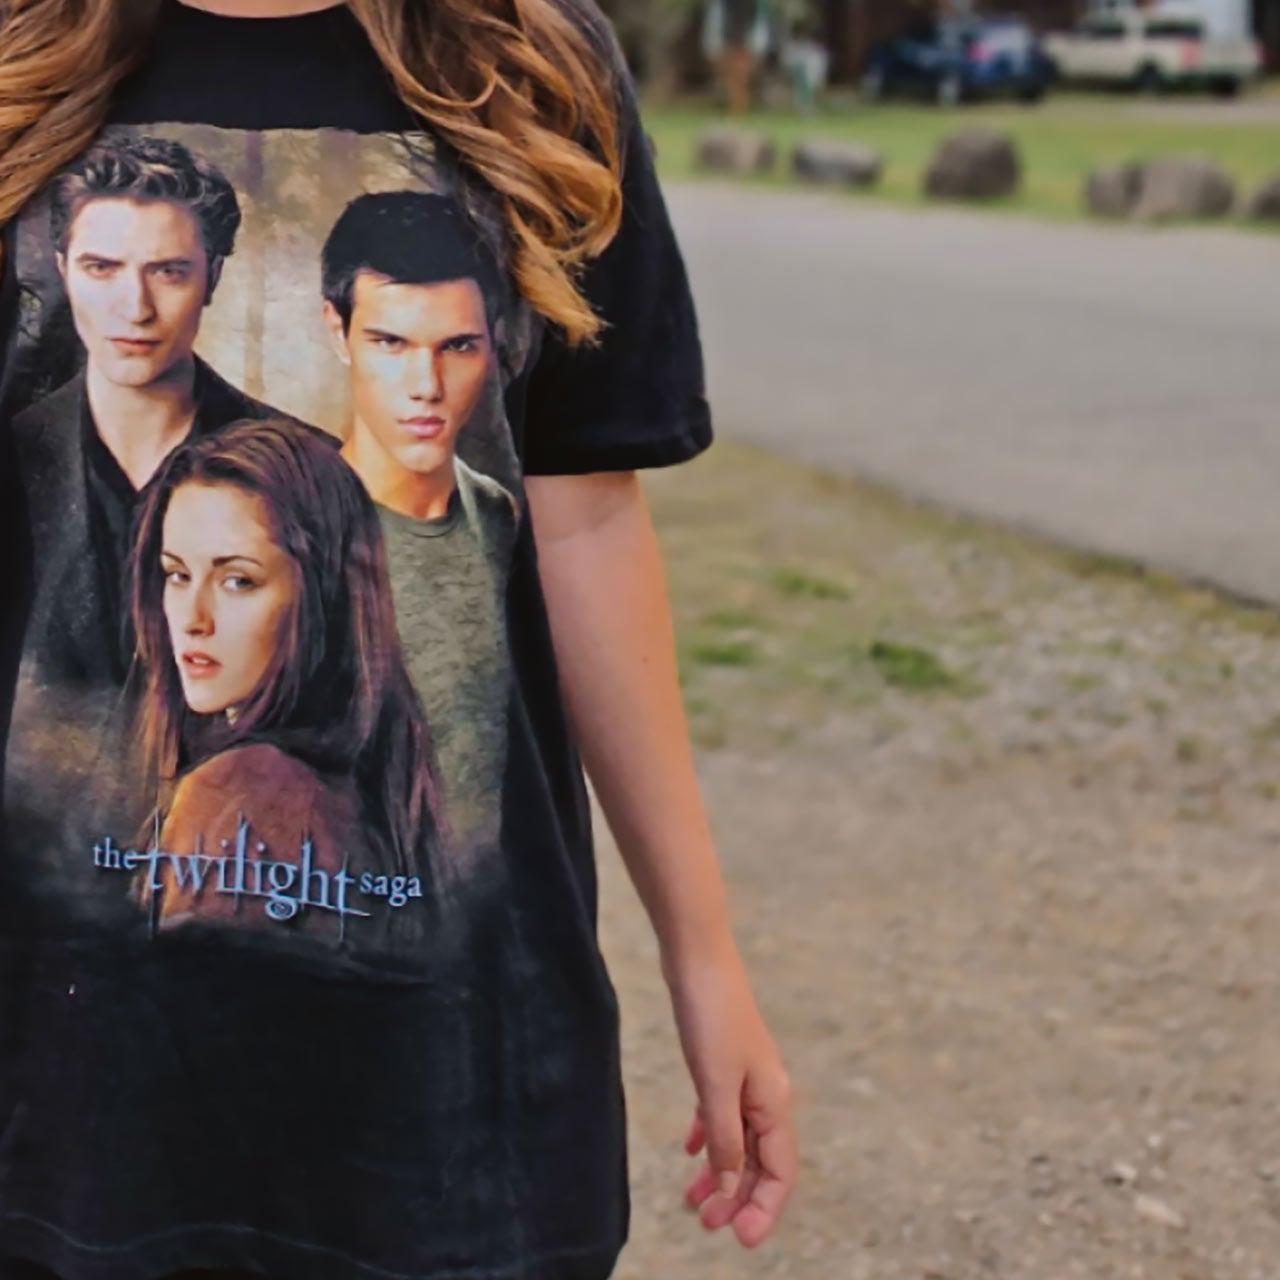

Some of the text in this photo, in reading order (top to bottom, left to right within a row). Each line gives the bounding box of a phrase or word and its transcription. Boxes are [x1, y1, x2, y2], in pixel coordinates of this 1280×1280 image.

[92, 809, 423, 934] the twilight saga
